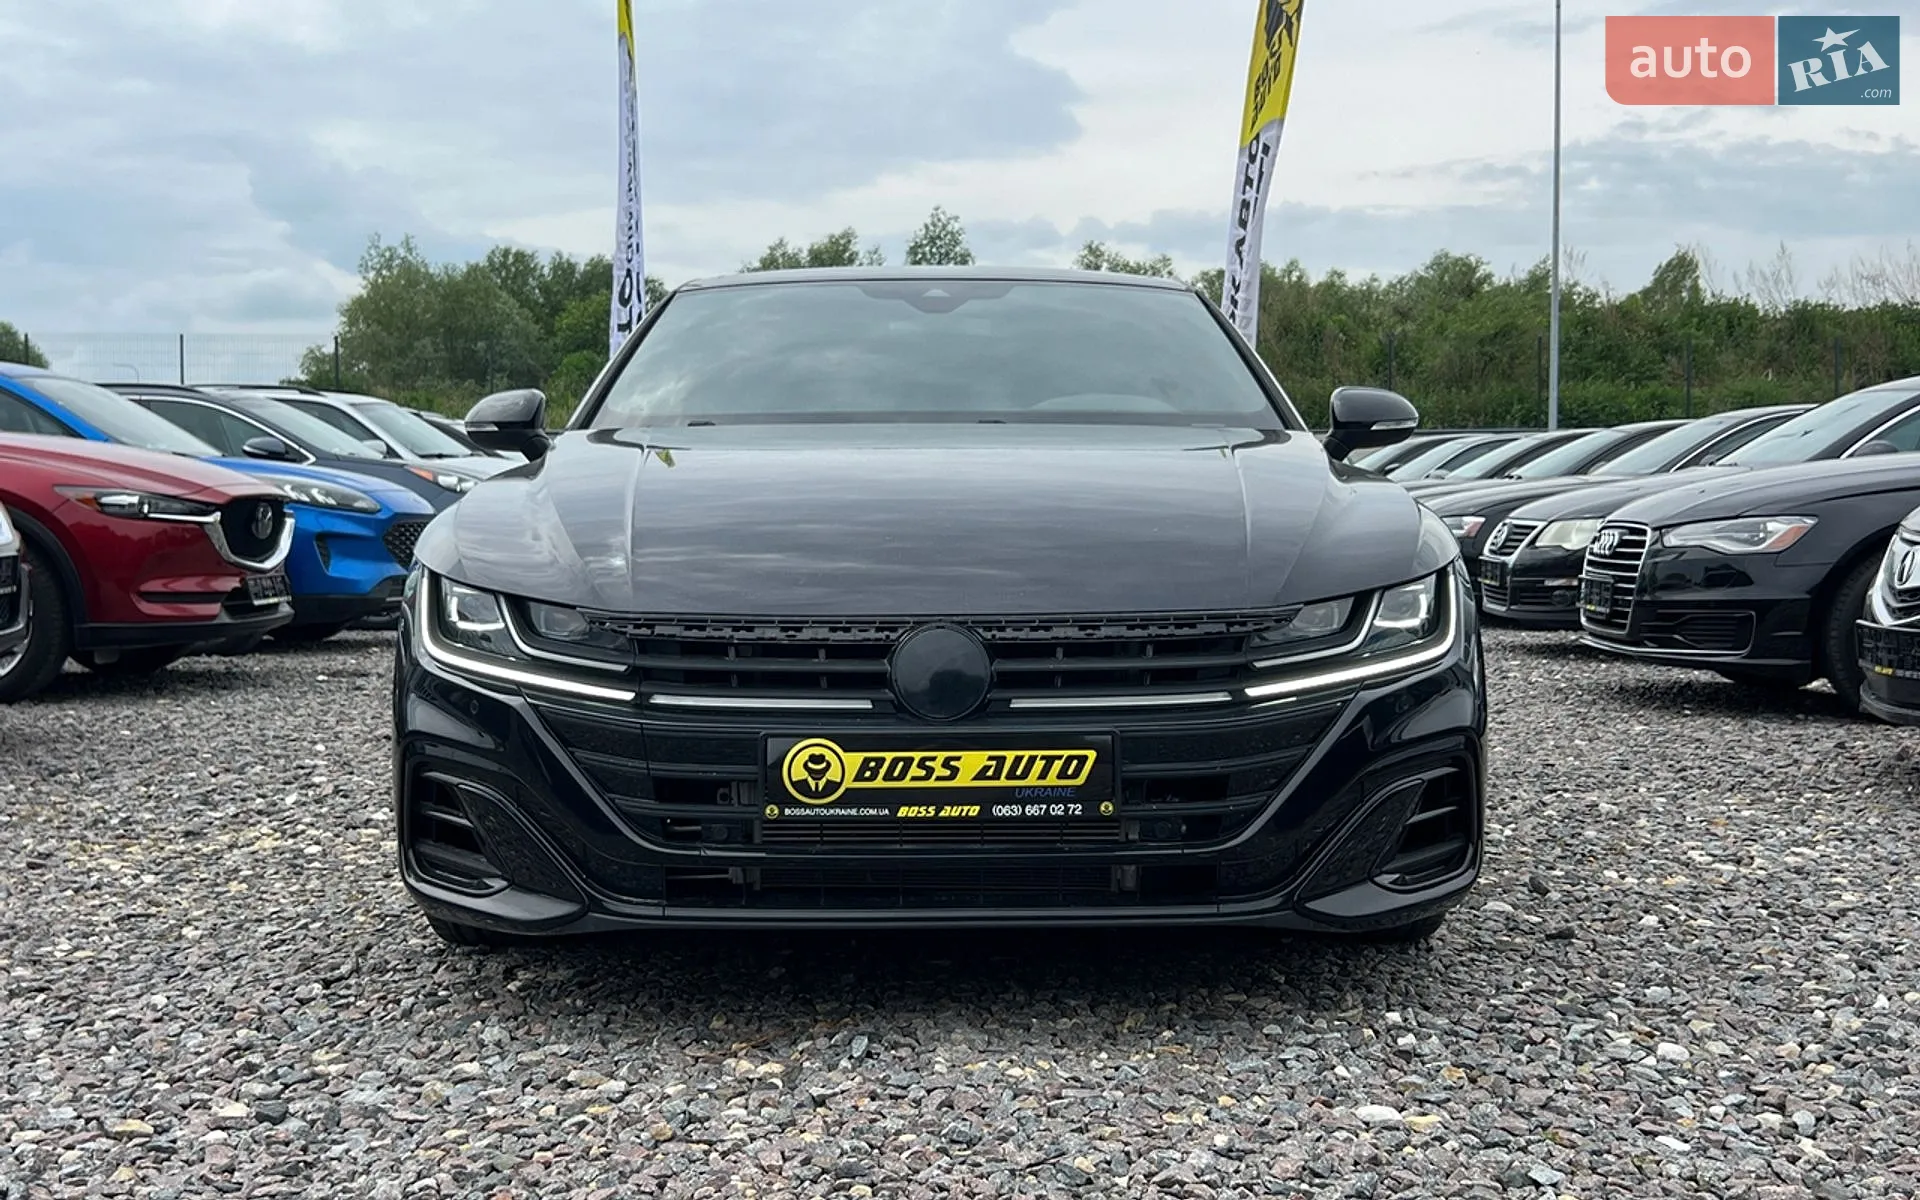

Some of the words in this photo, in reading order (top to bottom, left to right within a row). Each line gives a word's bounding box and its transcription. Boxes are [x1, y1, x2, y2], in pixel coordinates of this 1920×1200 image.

[852, 755, 963, 783] BOSS
[970, 754, 1090, 782] AUTO
[1015, 787, 1076, 798] UKRAINE
[784, 807, 890, 816] BOSSAUTOUKRAINE.COM.UA
[896, 805, 936, 817] BOSS
[939, 805, 981, 817] AUTO
[992, 804, 1023, 816] (063)
[1025, 804, 1046, 816] 667
[1050, 804, 1065, 815] 02
[1067, 804, 1083, 815] 72
